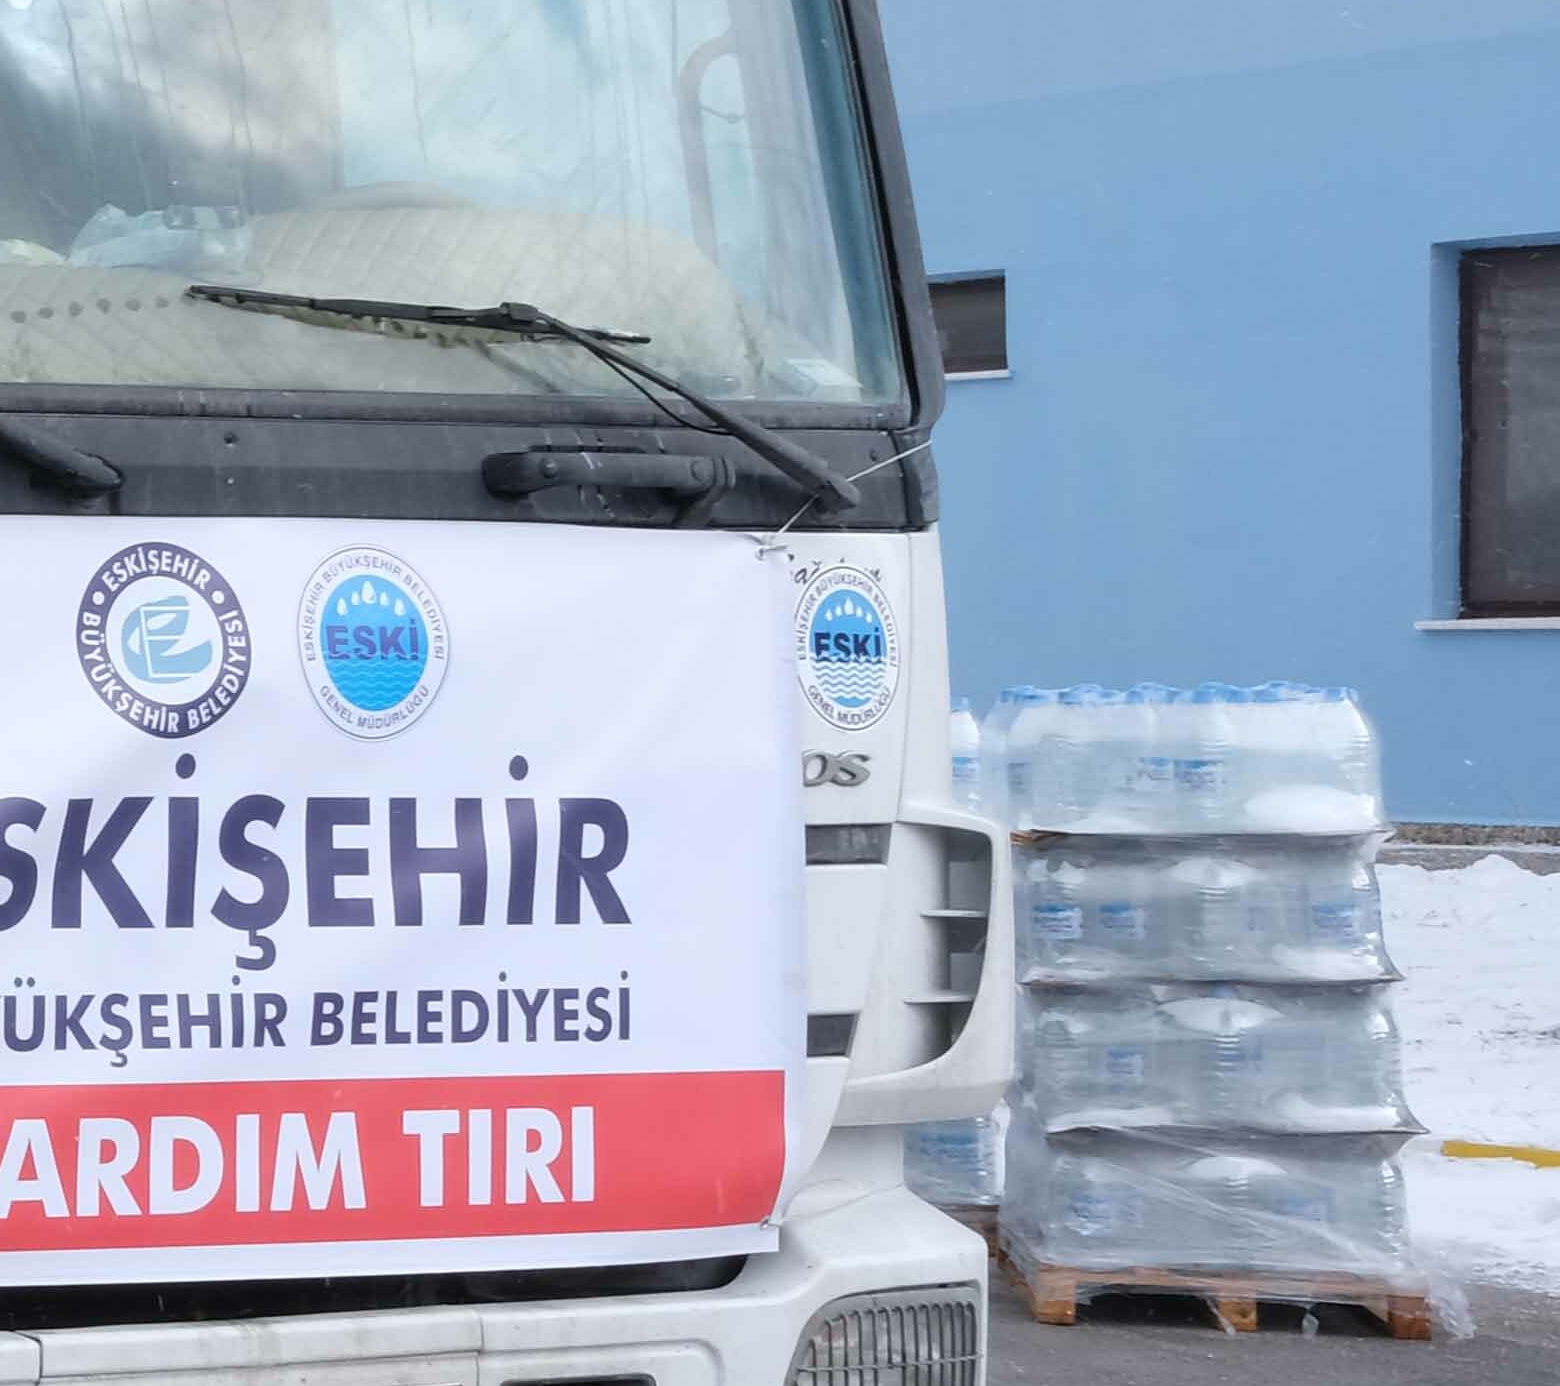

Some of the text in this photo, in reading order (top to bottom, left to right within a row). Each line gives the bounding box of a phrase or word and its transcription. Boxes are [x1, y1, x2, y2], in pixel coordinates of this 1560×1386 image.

[102, 547, 211, 592] ESKİŞEHİR
[326, 617, 419, 661] ESKİ
[814, 626, 883, 663] ESKİ
[80, 611, 179, 733] BÜYÜKŞEHİR
[310, 969, 632, 1047] BELEDİYESİ
[402, 1105, 595, 1208] TIRI
